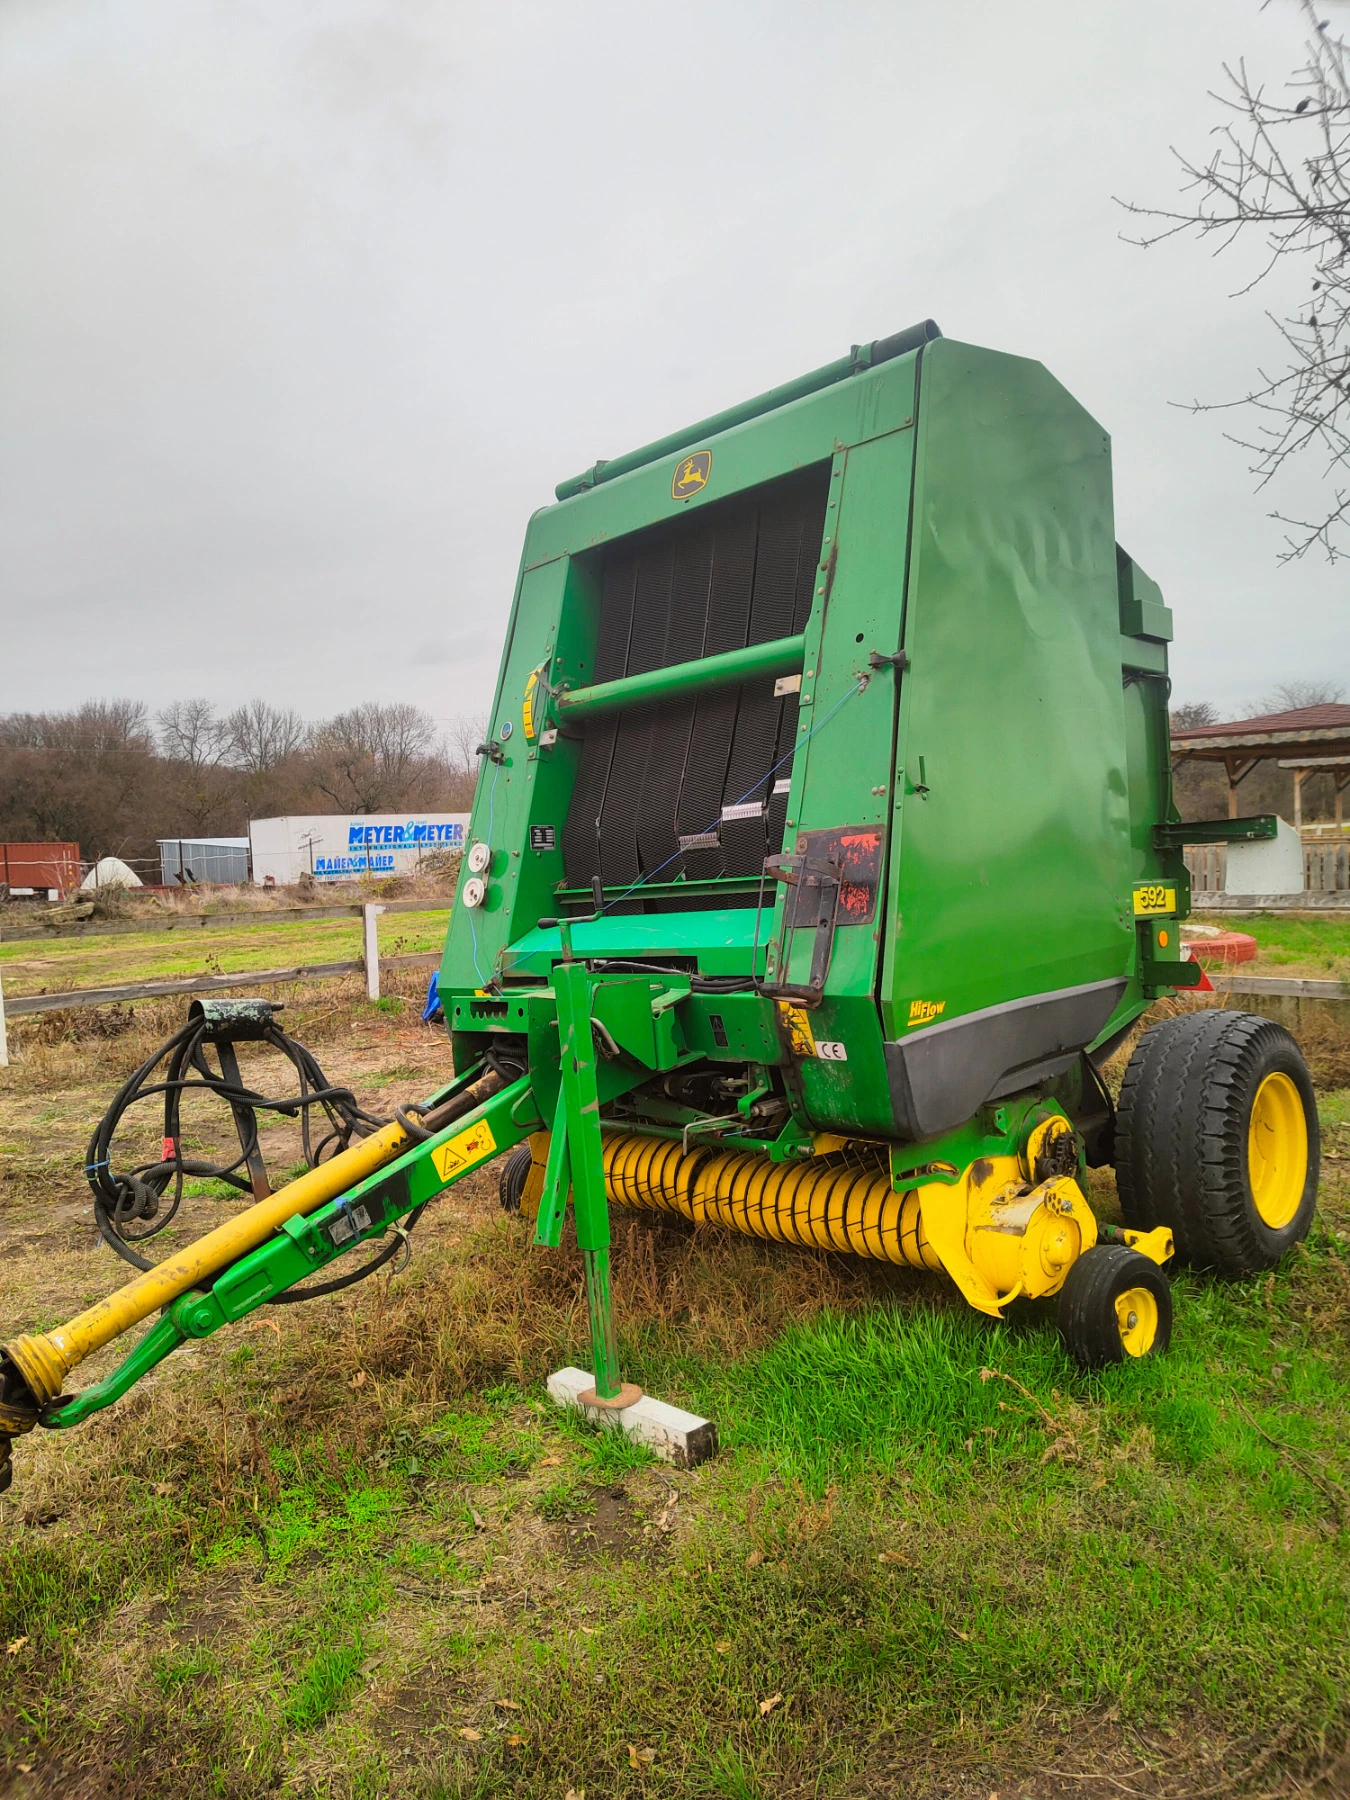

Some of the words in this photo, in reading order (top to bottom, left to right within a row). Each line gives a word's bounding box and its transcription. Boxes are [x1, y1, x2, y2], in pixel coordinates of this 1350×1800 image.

[348, 820, 464, 844] MEYER&MEYER
[1140, 885, 1166, 909] 592
[909, 1000, 946, 1018] HiFlow
[821, 1043, 842, 1059] CE
